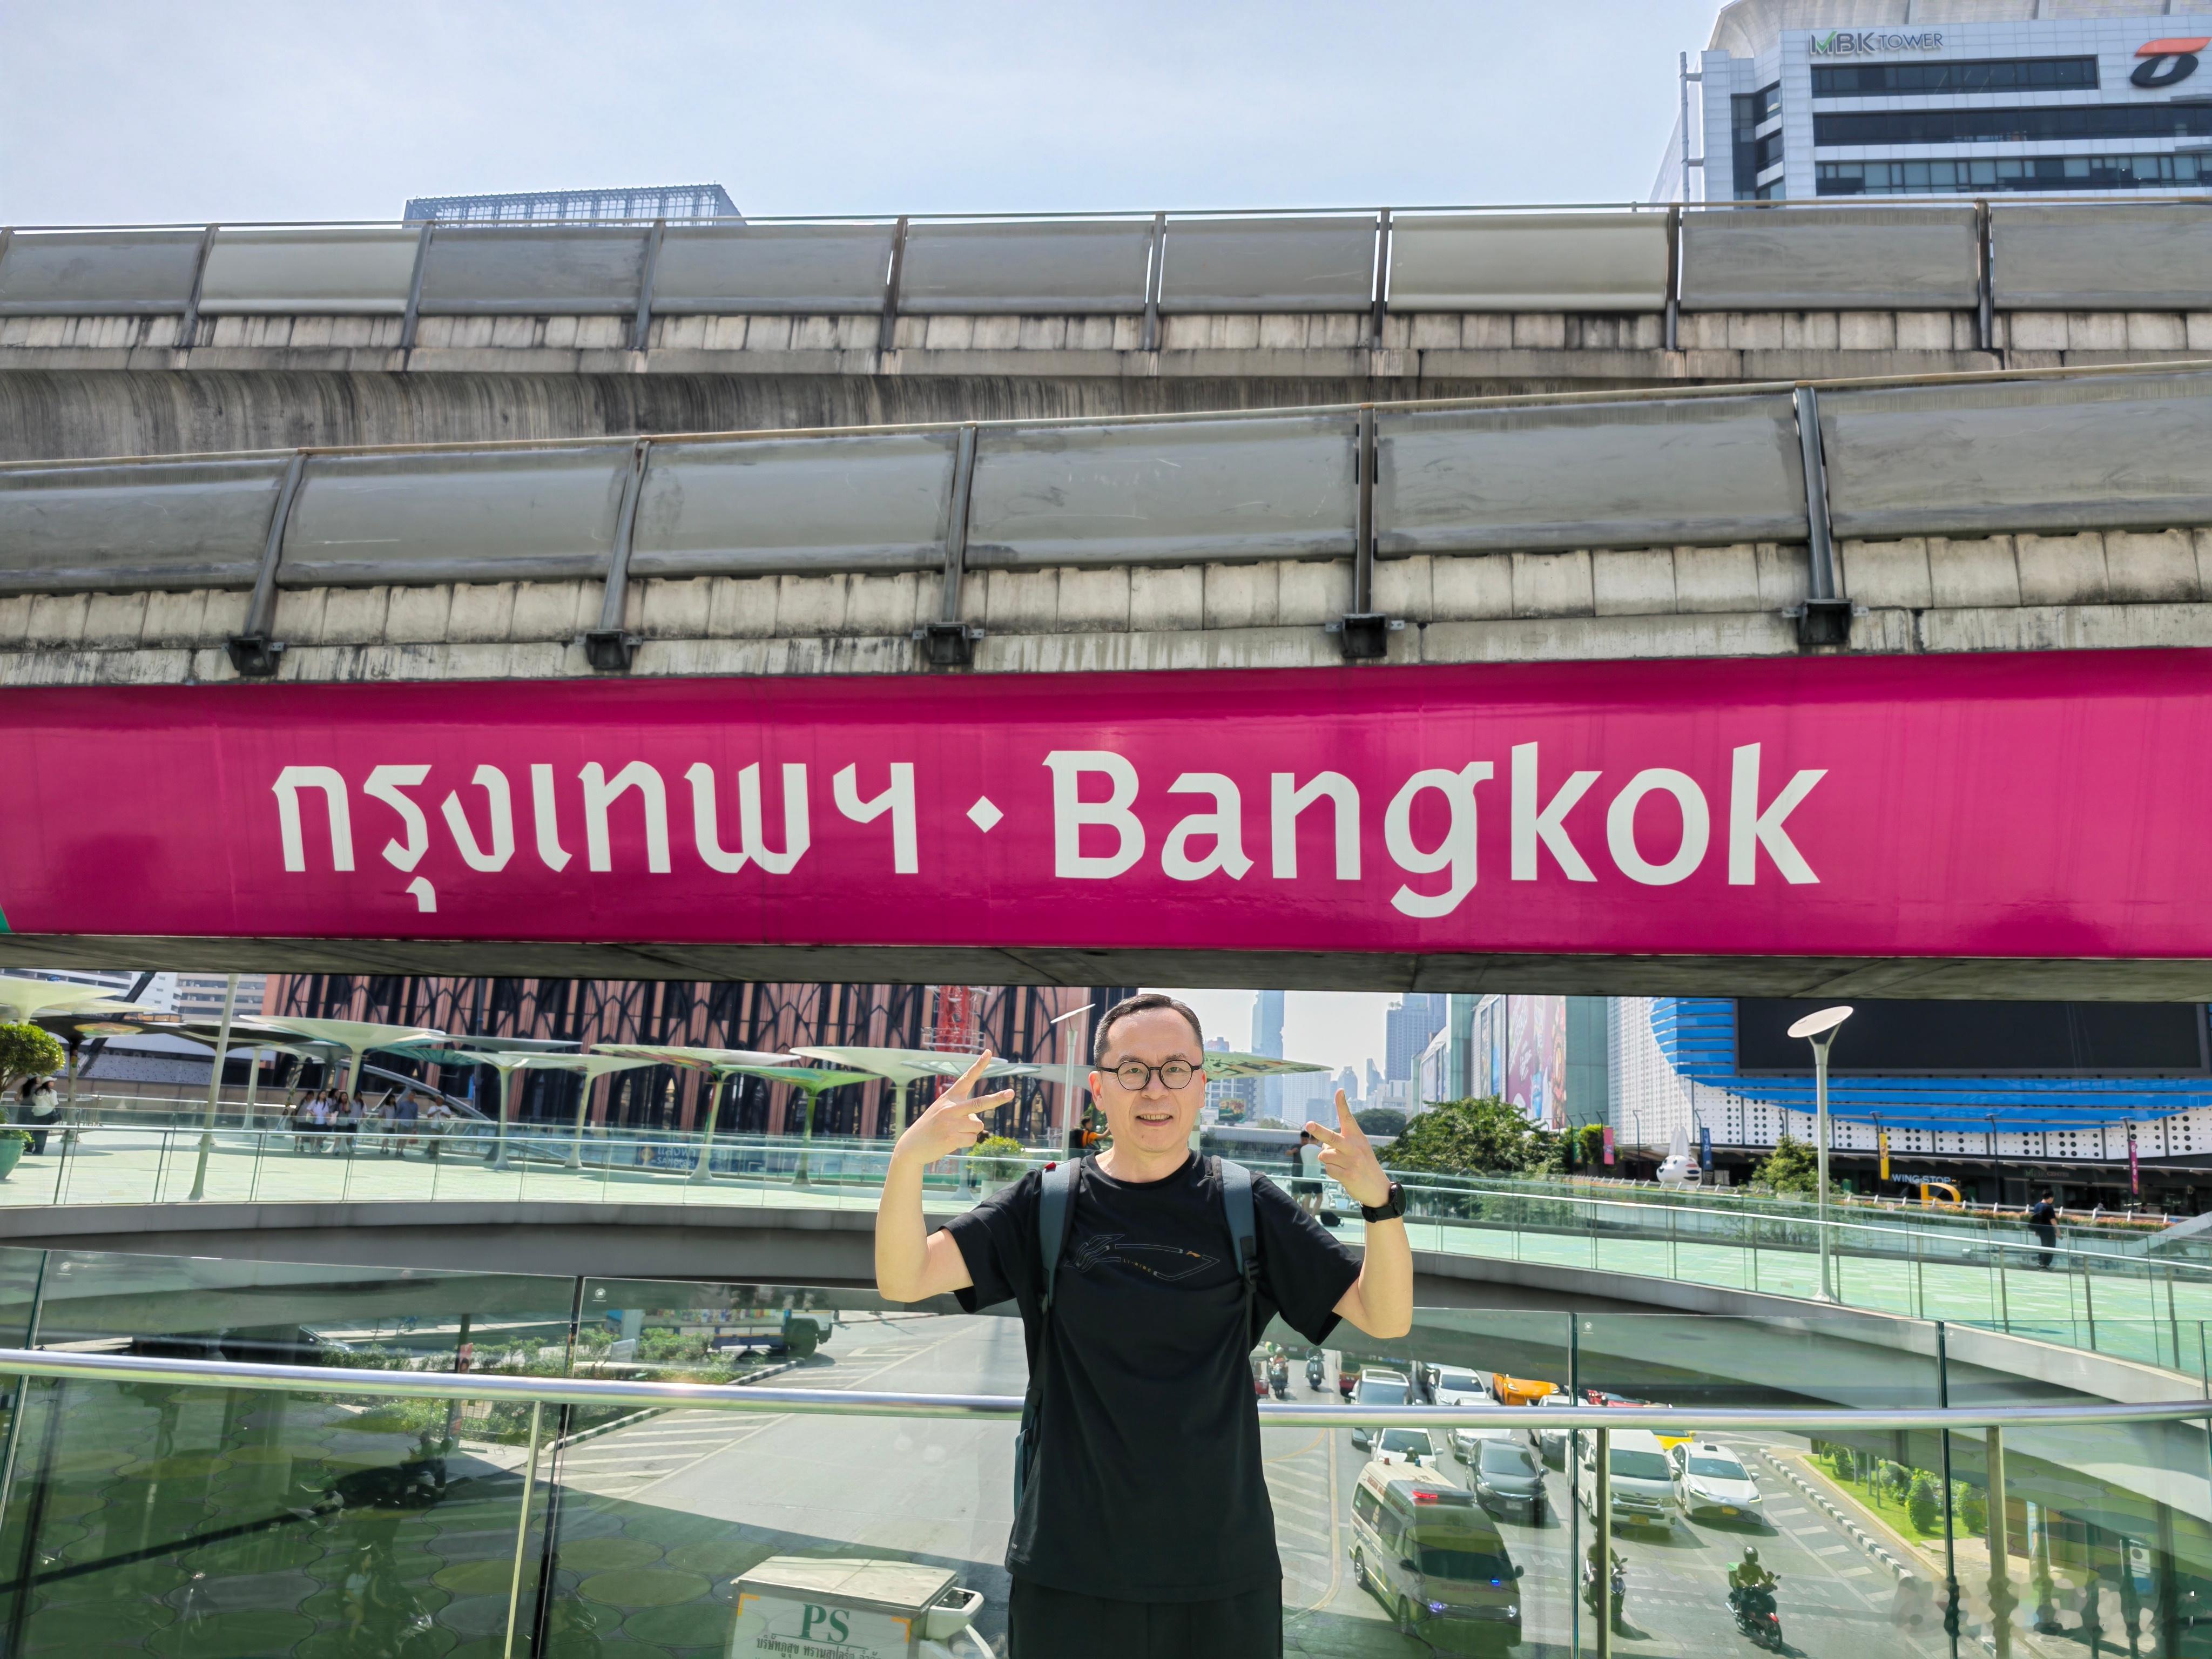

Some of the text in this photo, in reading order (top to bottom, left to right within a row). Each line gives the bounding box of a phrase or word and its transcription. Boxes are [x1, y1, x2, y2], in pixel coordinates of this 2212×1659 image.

[1811, 31, 1944, 53] MBK TOWER
[271, 760, 919, 913] กรุงเทพฯ
[1043, 741, 1829, 918] Bangkok
[1123, 1258, 1151, 1272] LI-NING
[799, 1603, 849, 1643] PS
